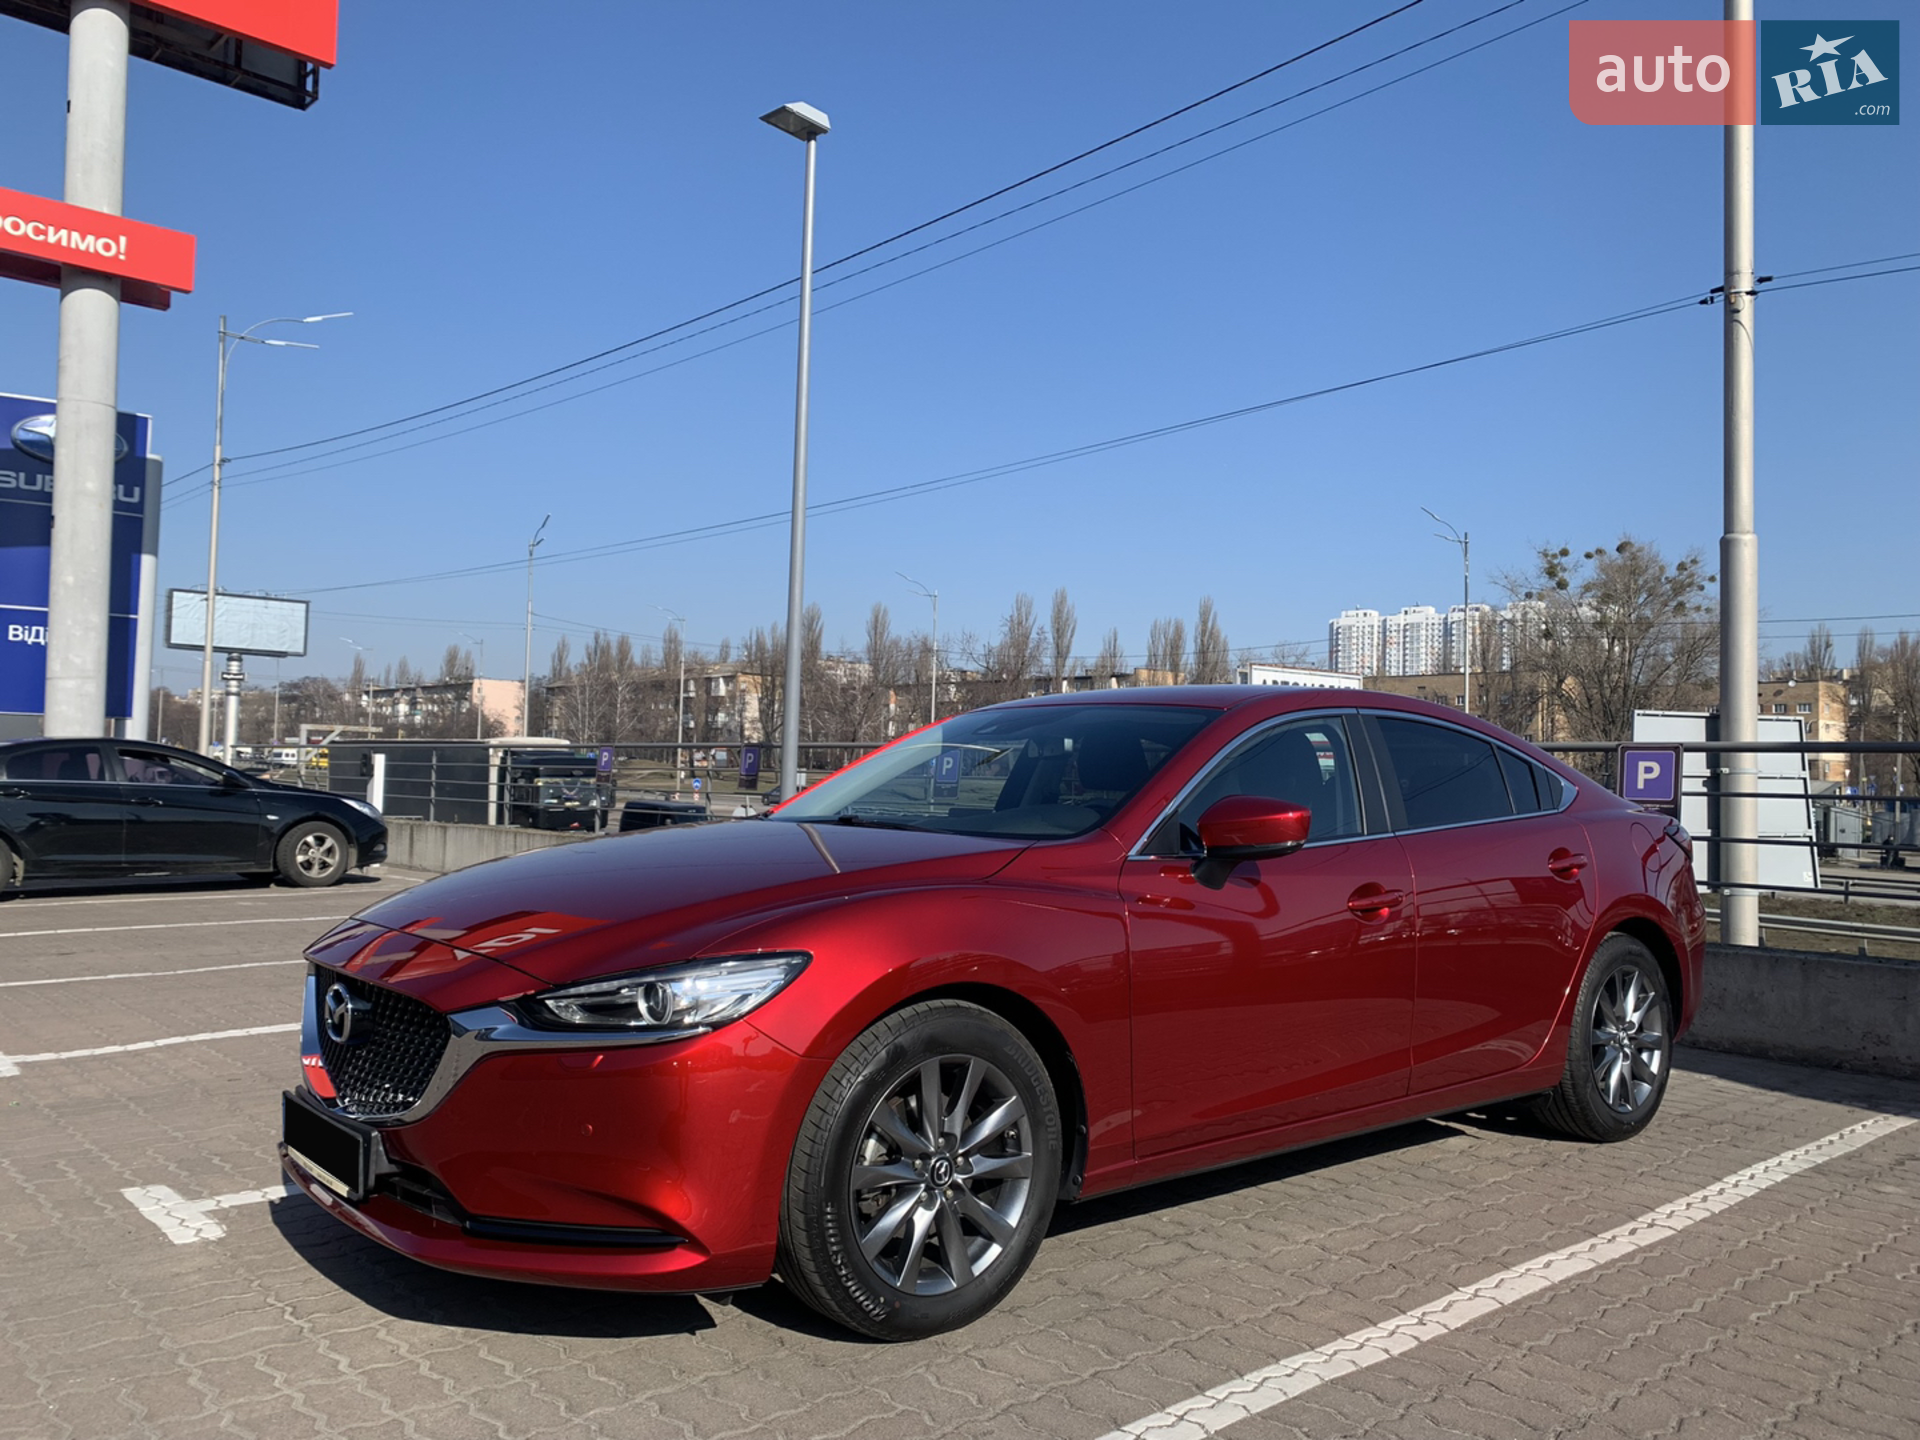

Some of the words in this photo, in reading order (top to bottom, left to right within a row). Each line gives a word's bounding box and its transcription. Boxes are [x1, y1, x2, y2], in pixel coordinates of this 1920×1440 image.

[601, 752, 609, 766] P
[745, 752, 755, 769] P
[942, 756, 954, 776] P
[1637, 761, 1661, 790] P
